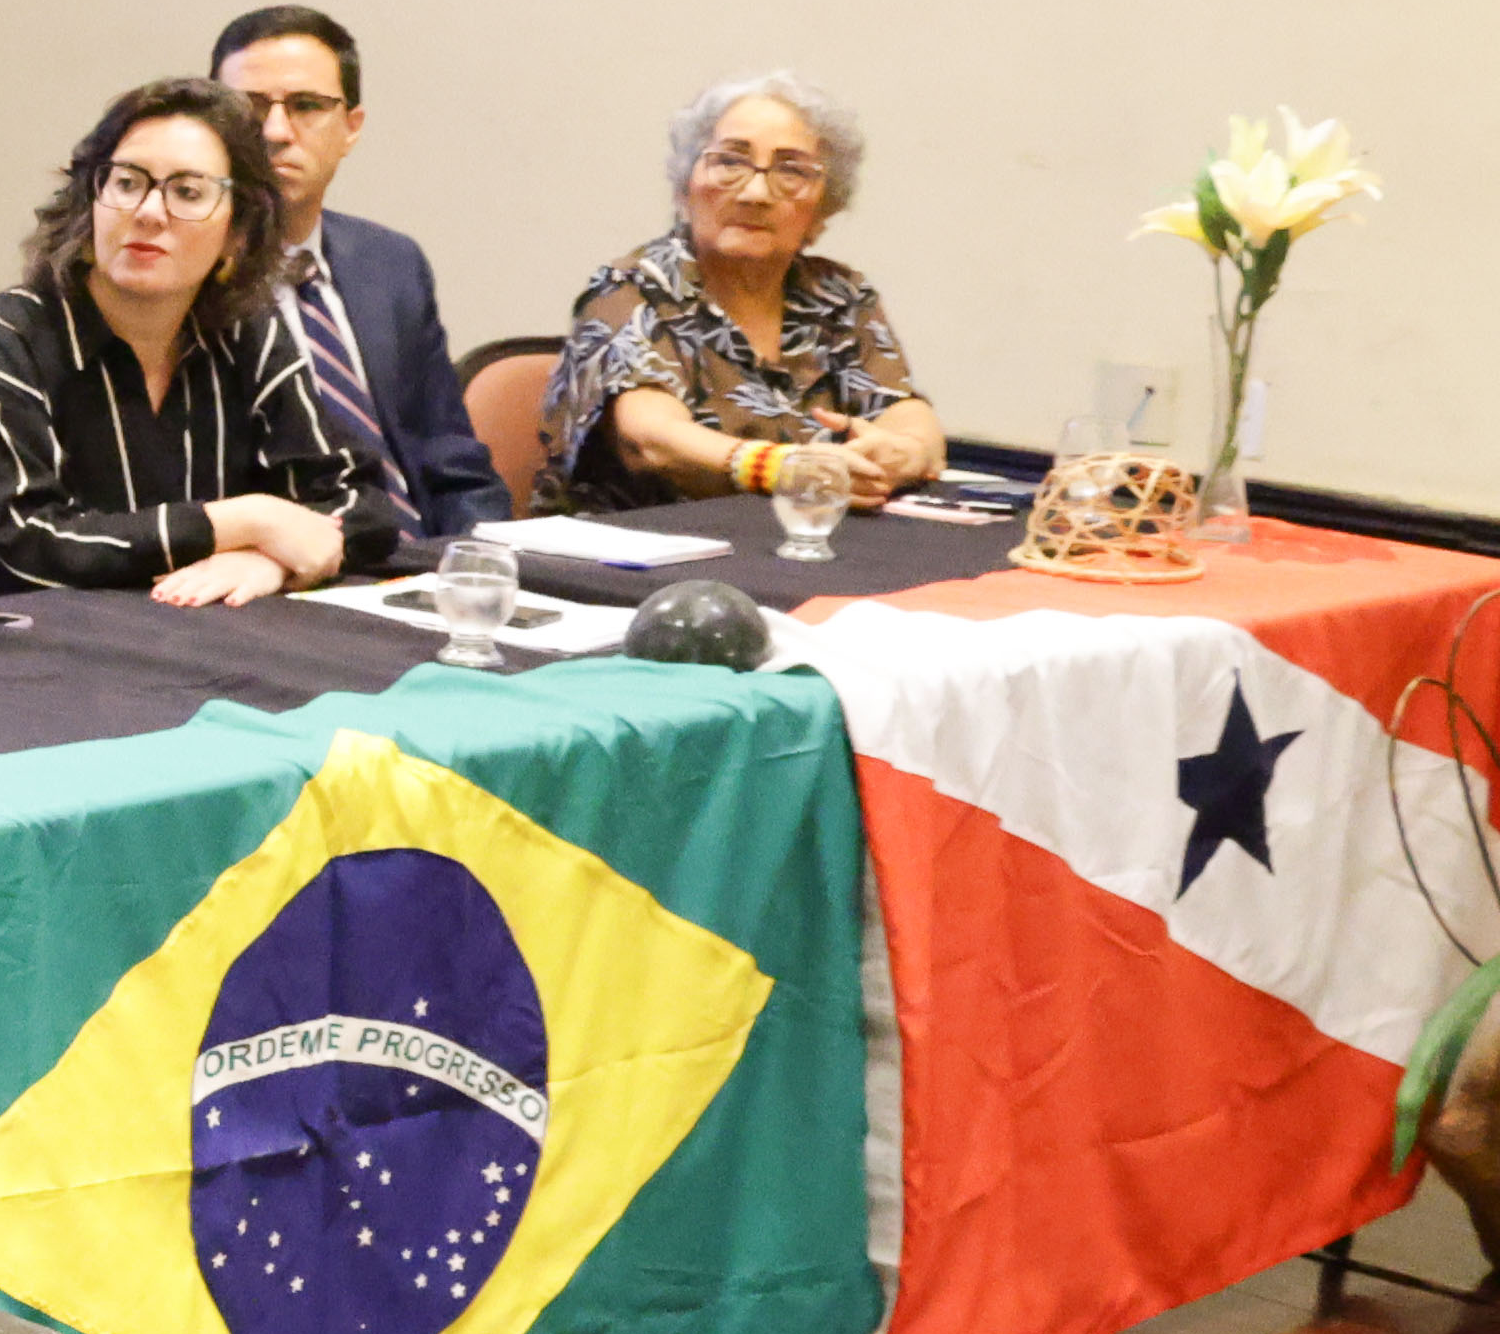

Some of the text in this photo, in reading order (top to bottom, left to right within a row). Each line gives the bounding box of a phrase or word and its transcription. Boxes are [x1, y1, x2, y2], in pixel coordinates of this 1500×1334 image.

[203, 1022, 543, 1123] ORDEM E PROGRESSO
